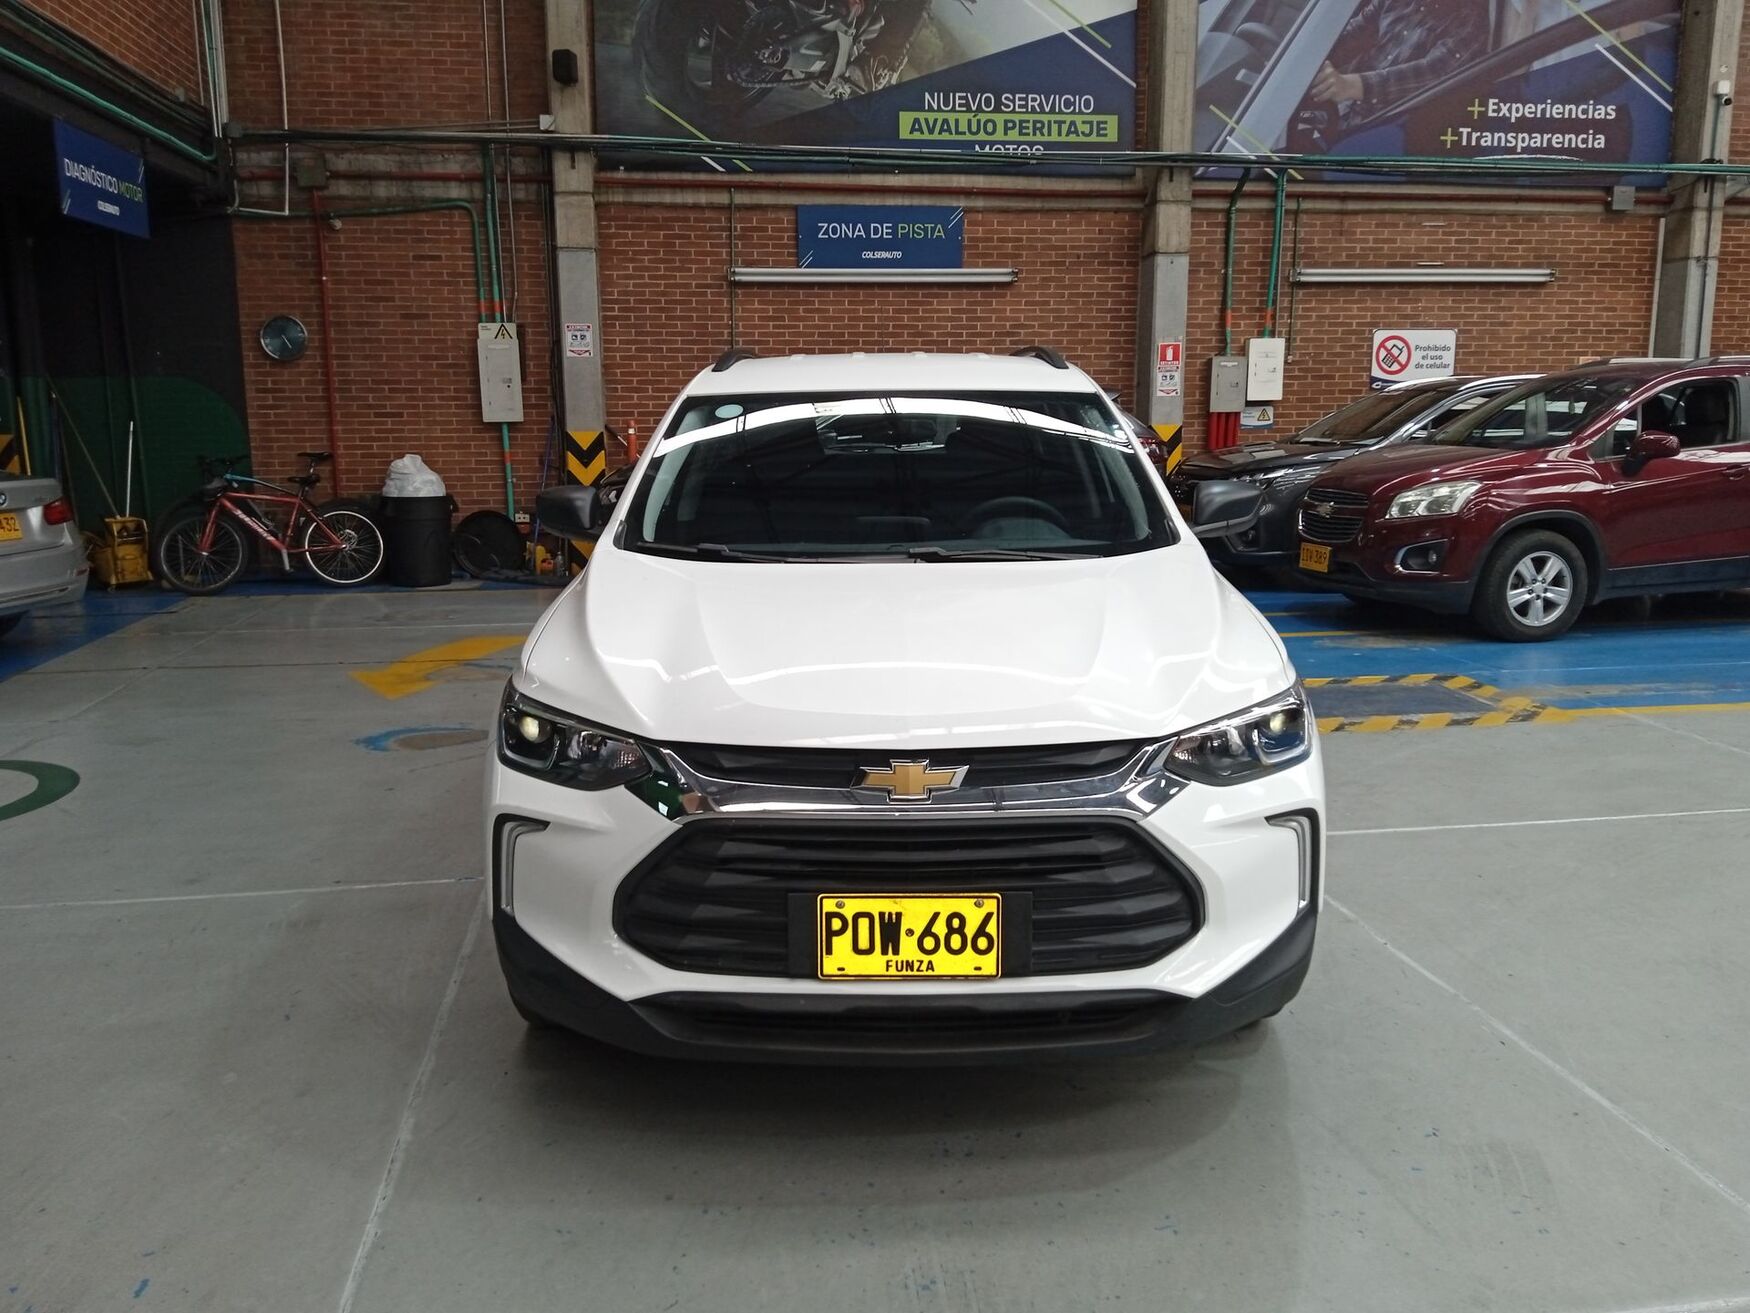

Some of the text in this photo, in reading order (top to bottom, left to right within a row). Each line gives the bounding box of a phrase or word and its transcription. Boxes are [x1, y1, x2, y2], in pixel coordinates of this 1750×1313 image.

[924, 92, 1095, 113] NUEVO SERVICIO
[909, 113, 1108, 137] AVALÚO PERITAJE
[64, 158, 144, 203] DIAGNÓSTICO MOTOR
[817, 223, 945, 239] ZONA DE PISTA
[862, 251, 903, 259] COLSERAUTO
[1414, 344, 1452, 352] Prohibido
[1421, 353, 1444, 361] el uso
[1414, 361, 1451, 369] de celular
[886, 960, 935, 973] FUNZA
